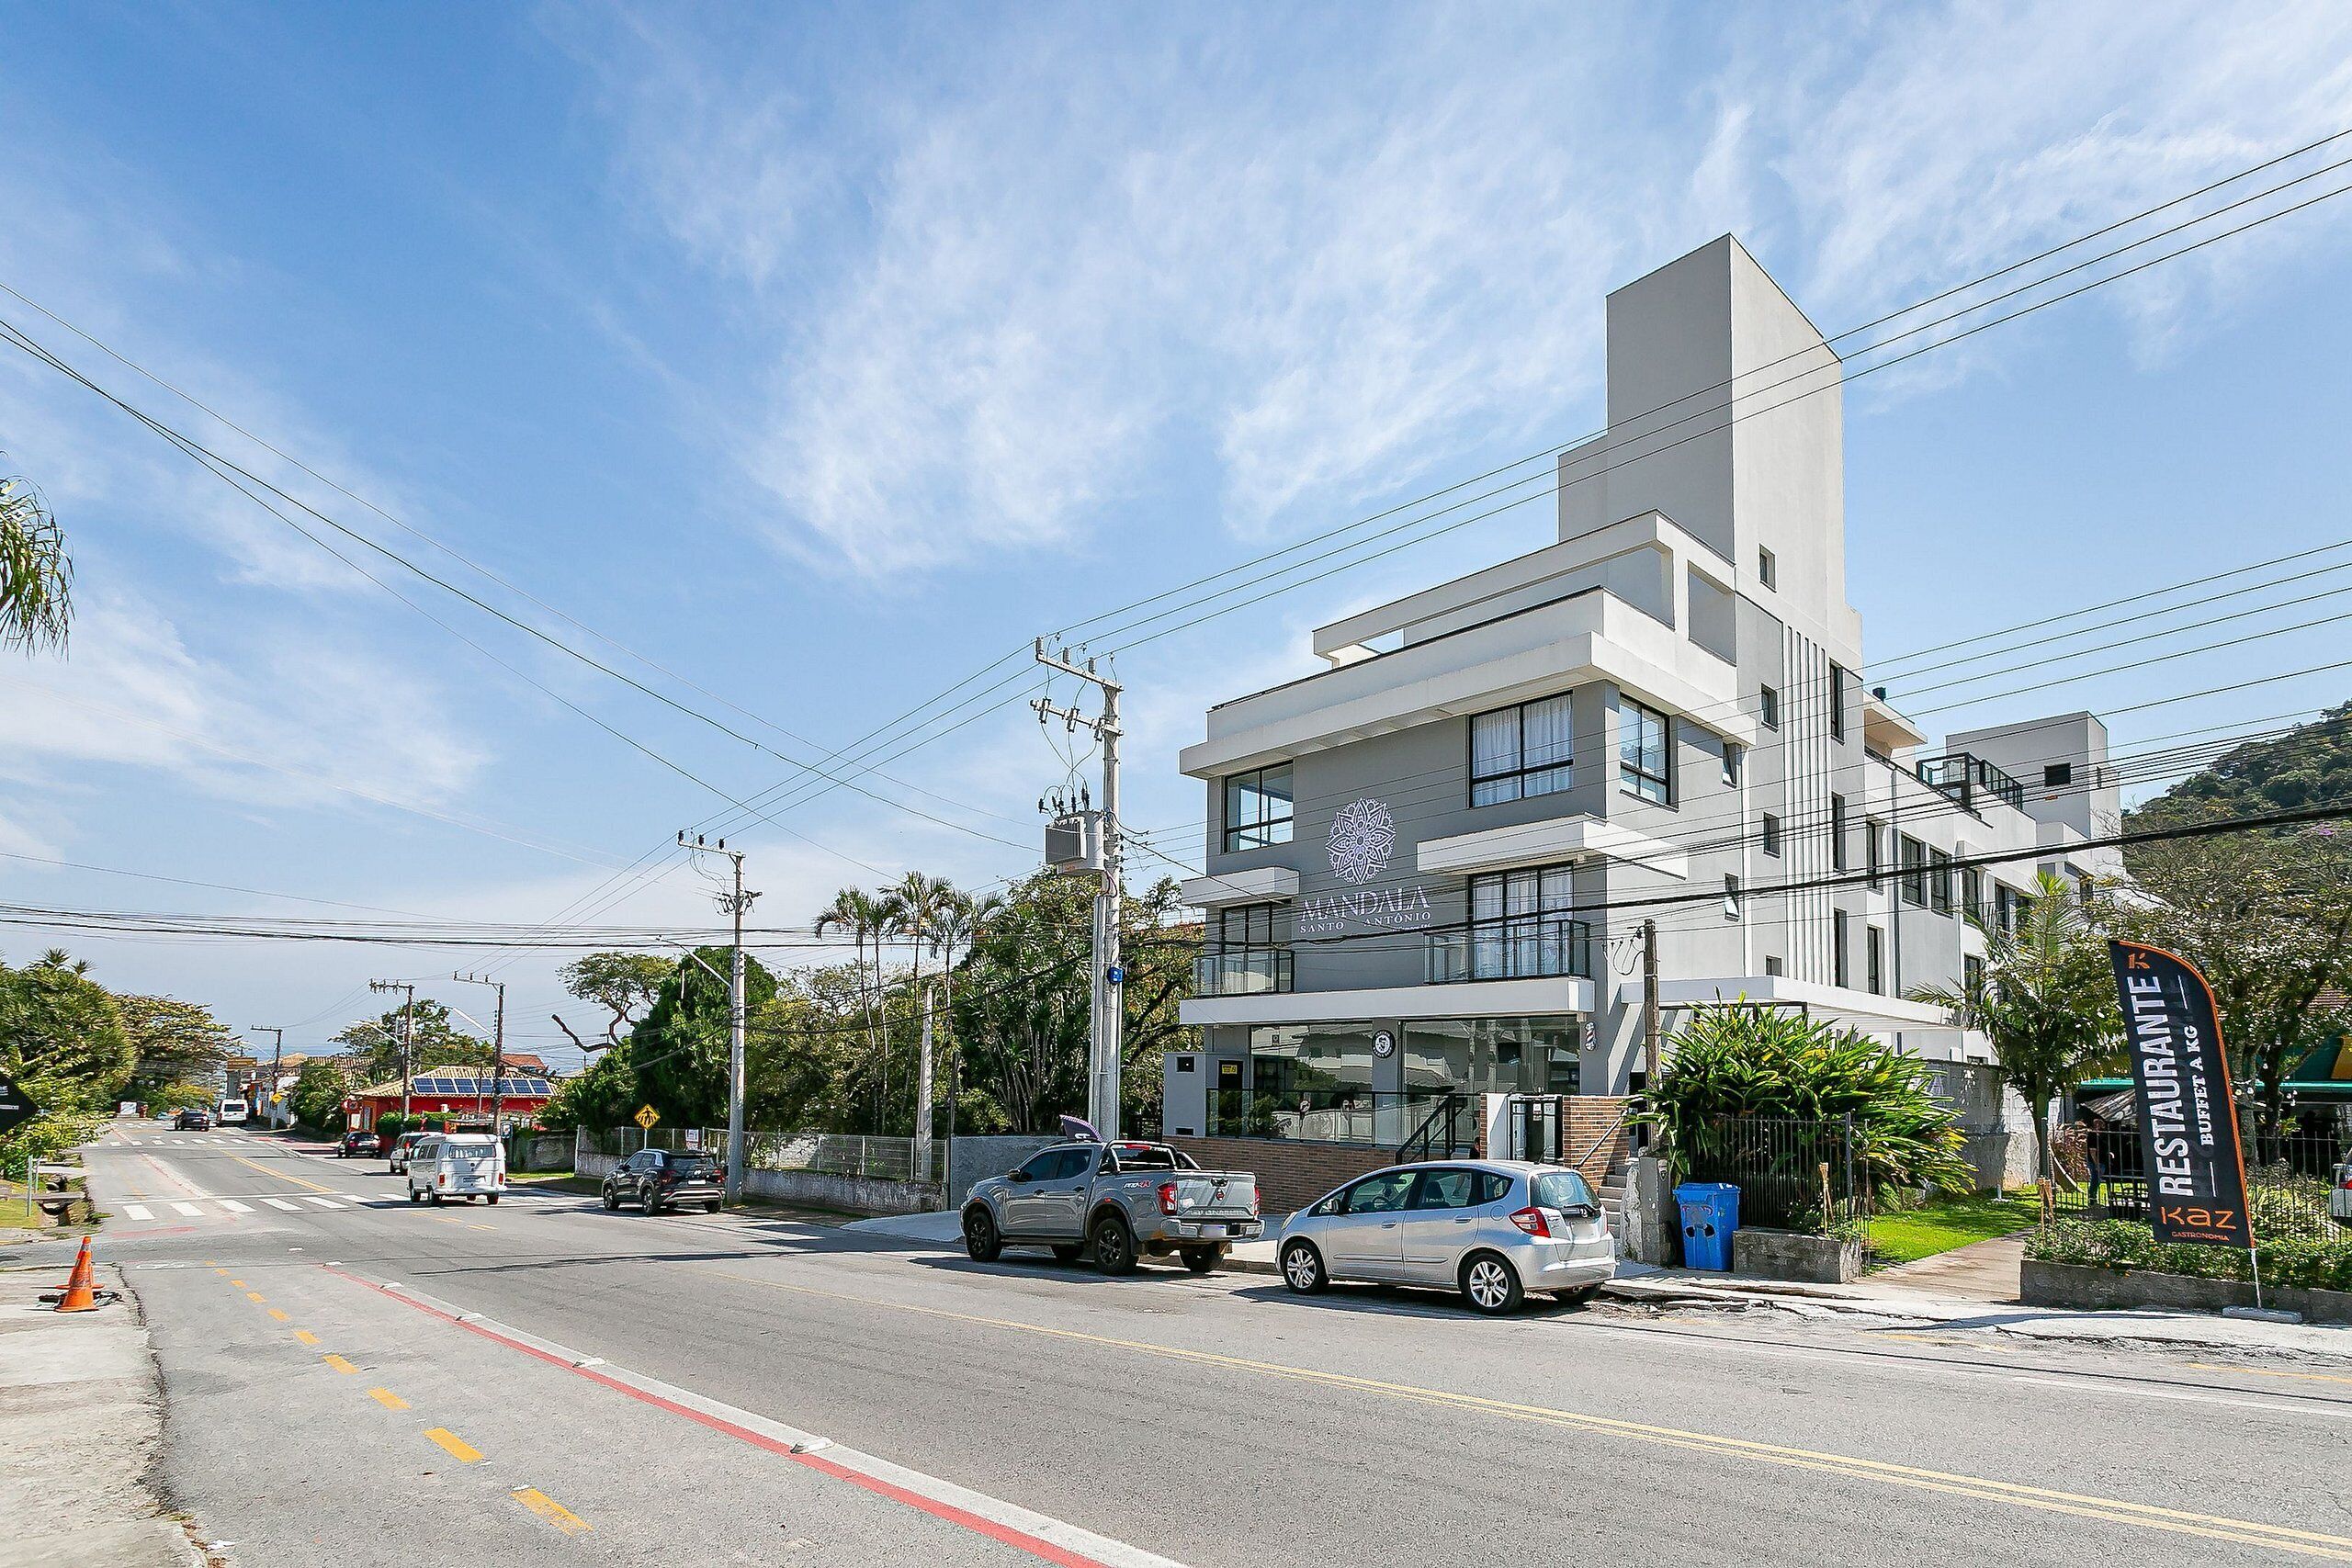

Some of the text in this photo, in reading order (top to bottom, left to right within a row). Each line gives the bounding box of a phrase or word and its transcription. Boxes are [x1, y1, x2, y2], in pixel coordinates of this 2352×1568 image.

[1300, 885, 1431, 921] MANDALA
[1300, 921, 1344, 933] SANTO
[1364, 911, 1431, 927] ANTÔNIO
[2127, 976, 2195, 1197] RESTAURANTE
[2184, 1025, 2214, 1146] BUFFET A KG
[2171, 1231, 2231, 1242] GASTRONOMIA
